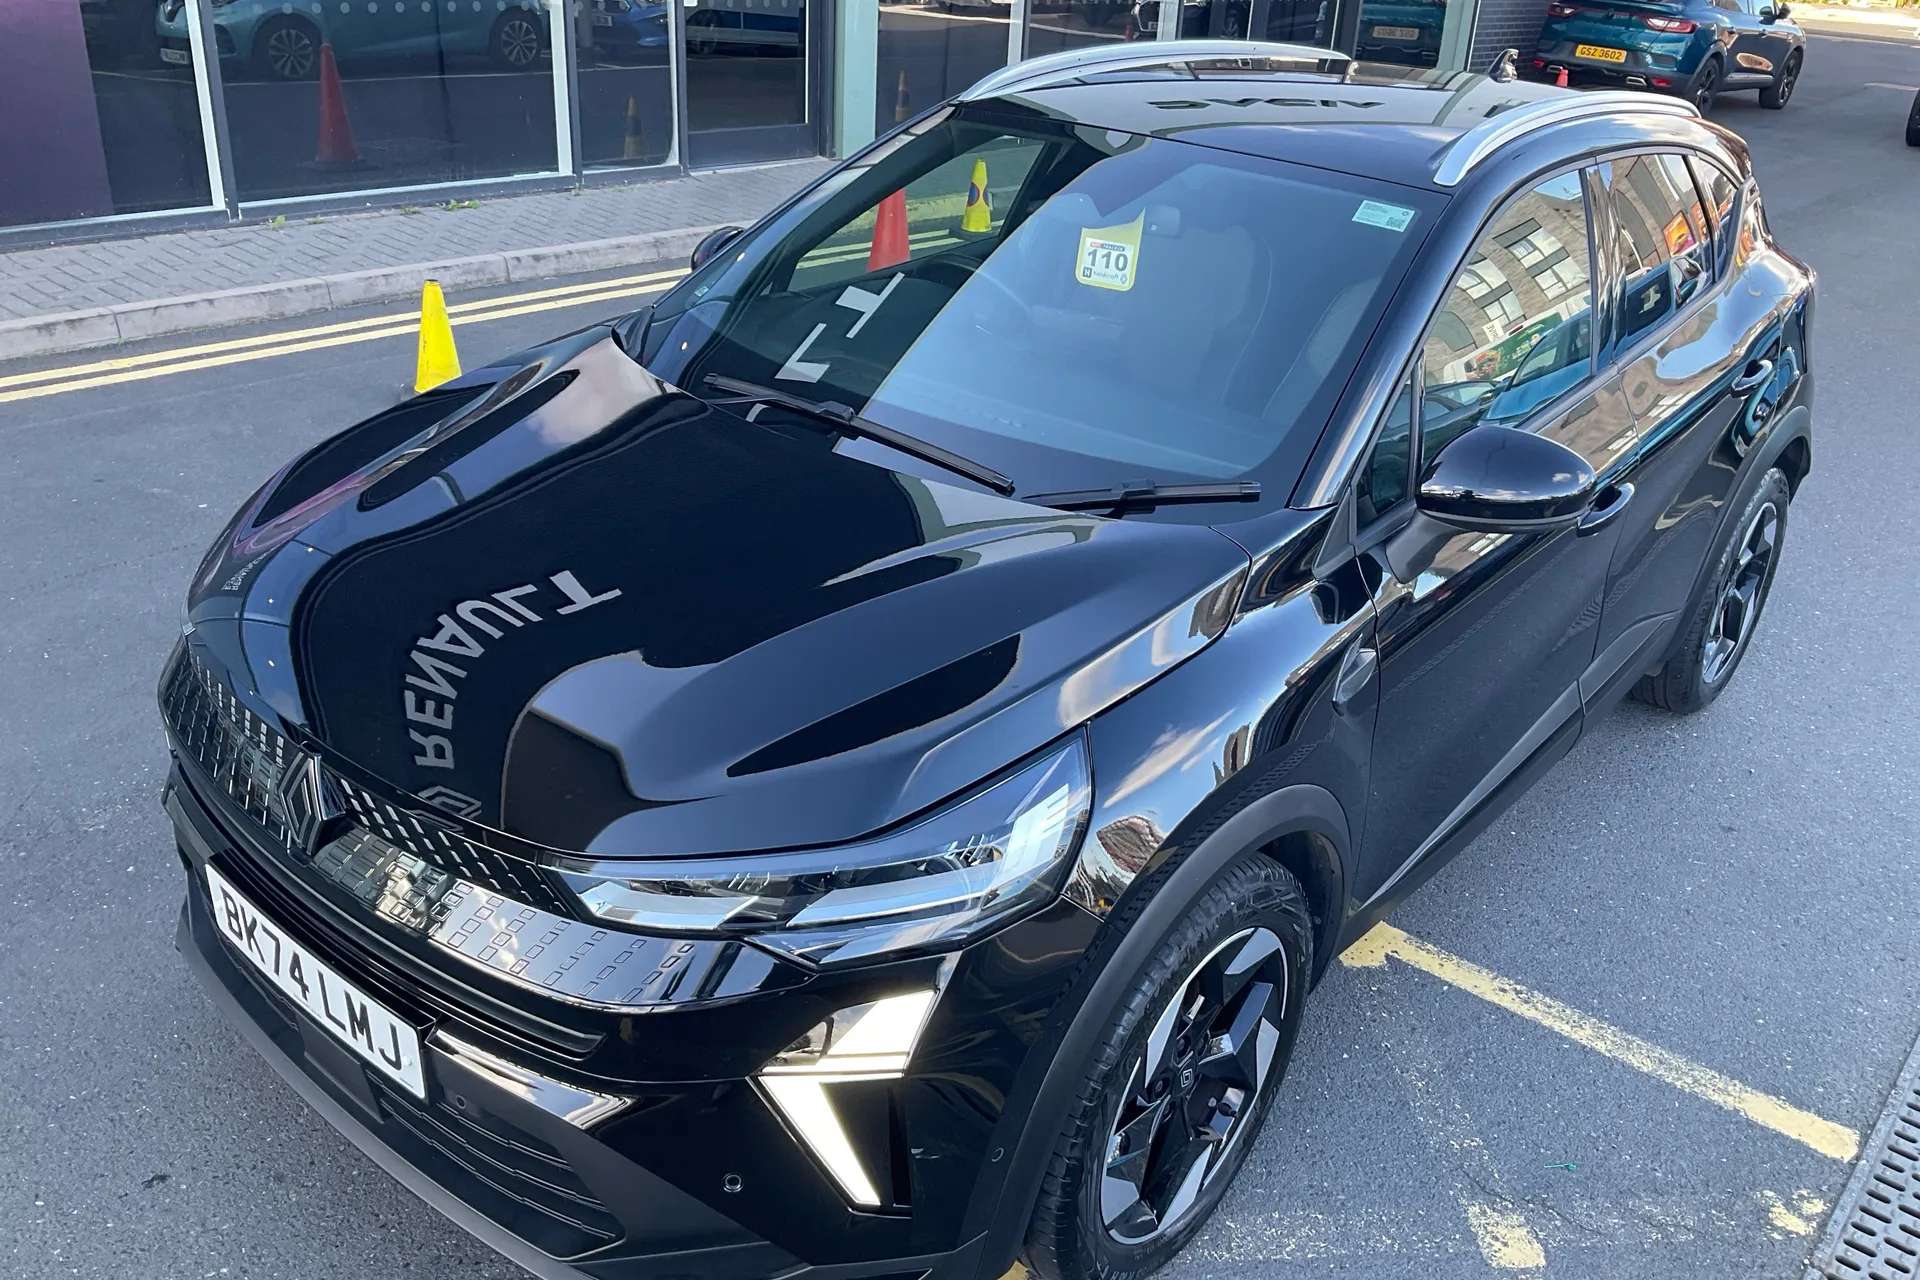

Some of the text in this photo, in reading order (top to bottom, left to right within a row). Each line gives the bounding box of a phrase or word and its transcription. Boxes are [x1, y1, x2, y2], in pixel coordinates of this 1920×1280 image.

[1580, 46, 1623, 61] GSZ 3602
[1087, 248, 1129, 272] 110
[220, 885, 403, 1072] BK74 LMJ
